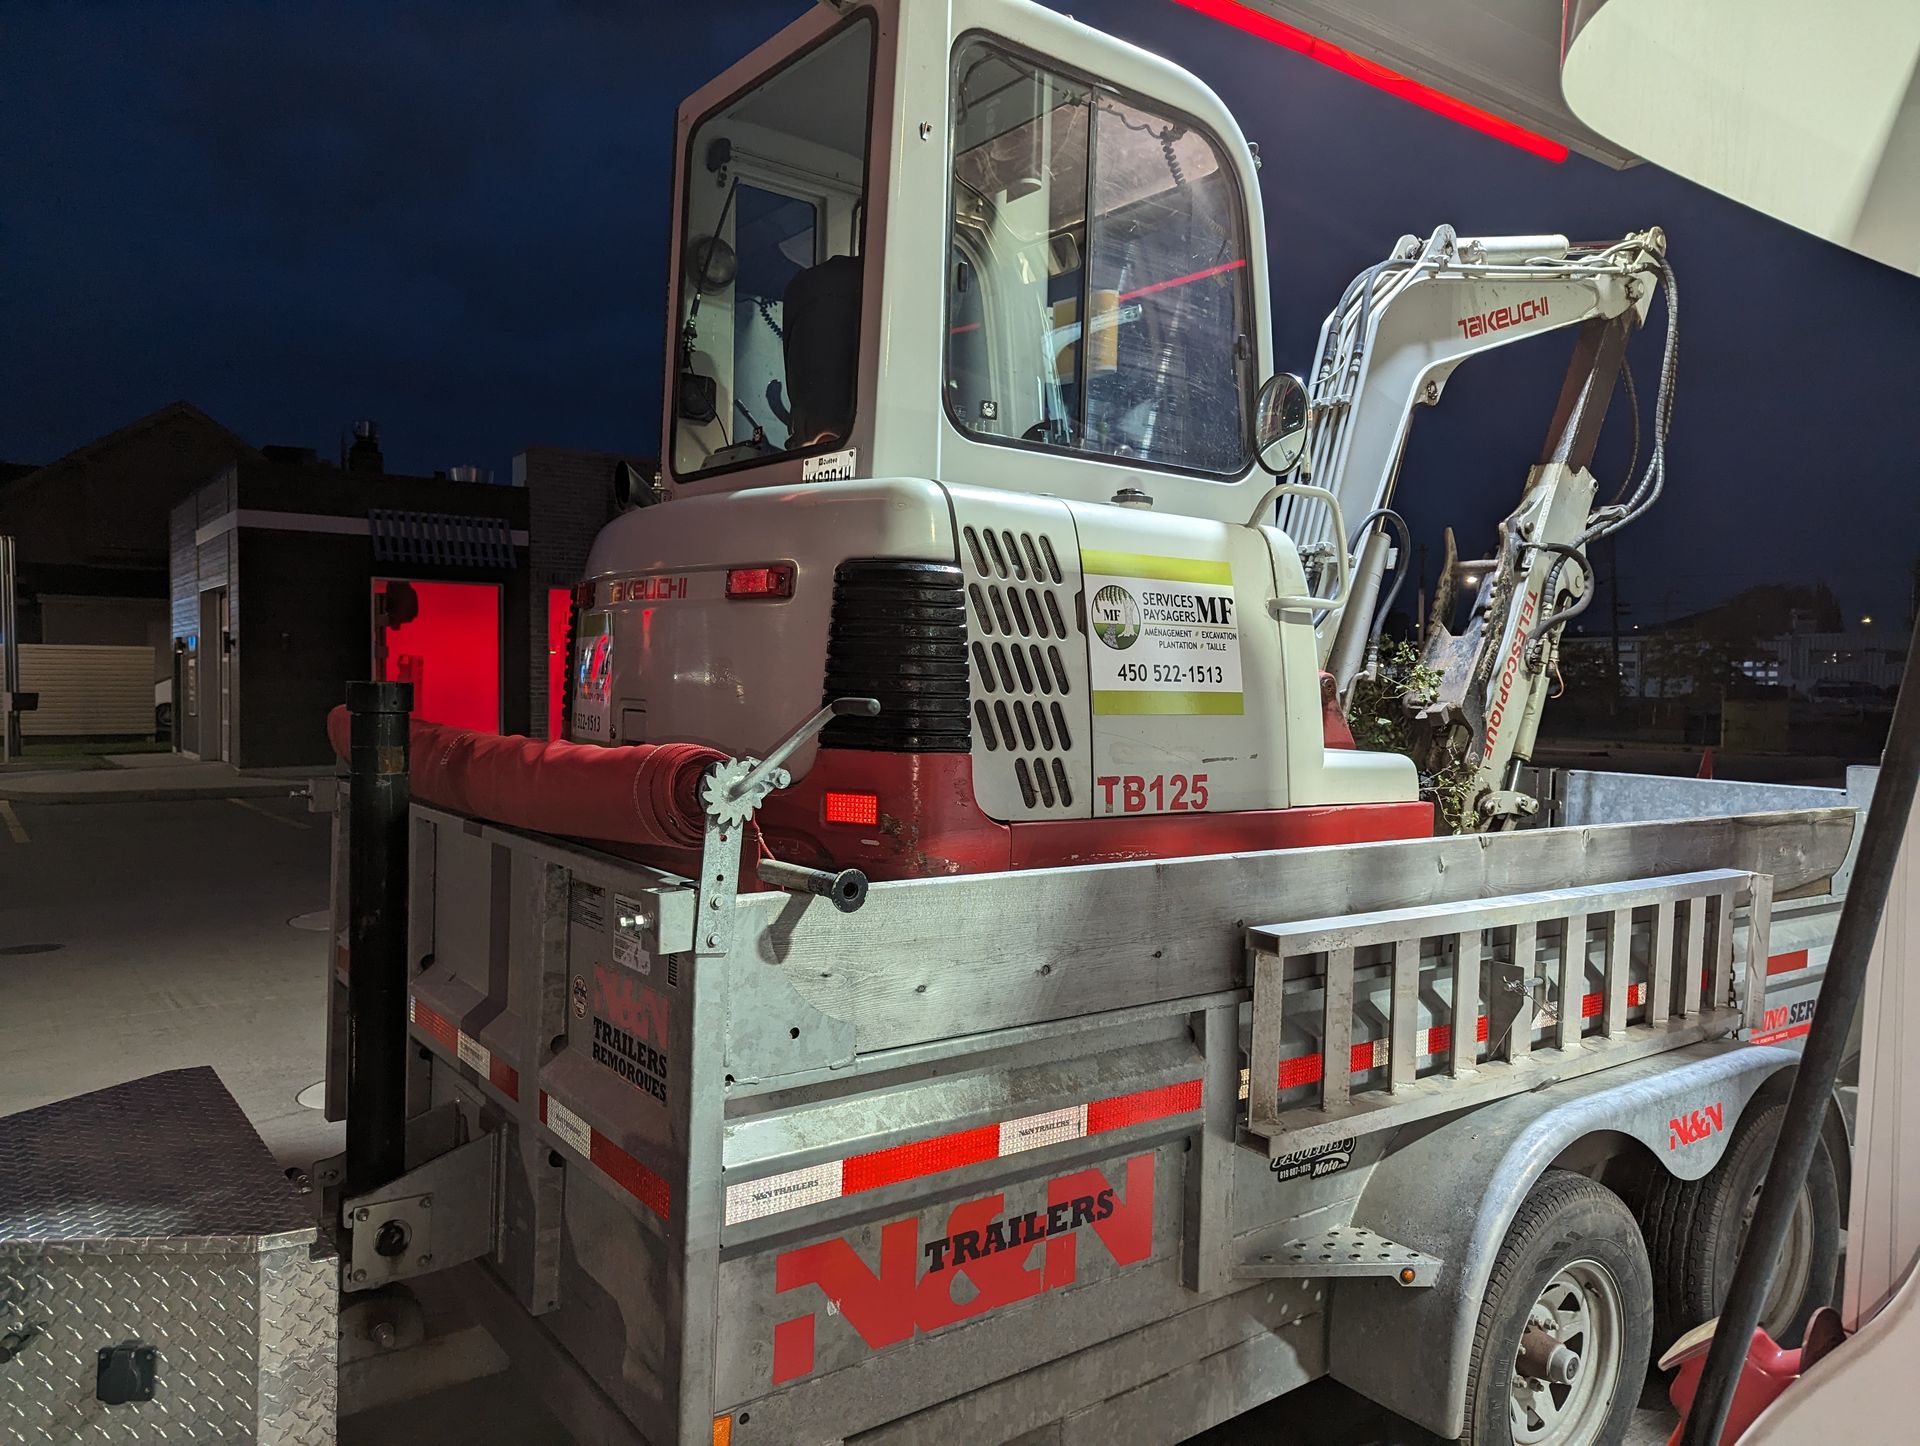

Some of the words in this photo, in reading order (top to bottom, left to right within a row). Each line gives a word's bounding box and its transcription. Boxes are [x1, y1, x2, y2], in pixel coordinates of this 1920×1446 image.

[1103, 609, 1121, 621] MF
[1142, 592, 1193, 608] SERVICES
[1195, 595, 1234, 625] MF
[1143, 608, 1196, 623] PAYSAGERS
[1144, 627, 1192, 638] AMÉNAGEMENT
[1201, 631, 1237, 640] EXCAVATION
[1158, 641, 1198, 650] PLANTATION
[1206, 642, 1227, 651] TAILLE
[1118, 664, 1147, 682] 450
[1153, 664, 1223, 684] 522-1513
[1483, 590, 1538, 761] TELESCOPIQUE
[1096, 773, 1209, 813] TB125
[593, 1016, 668, 1079] TRAILERS
[592, 1041, 667, 1102] REMORQUES
[1669, 1102, 1722, 1151] N&N
[773, 1179, 819, 1198] TRAILERS
[923, 1188, 1115, 1274] TRAILERS
[771, 1152, 1155, 1387] N&N
